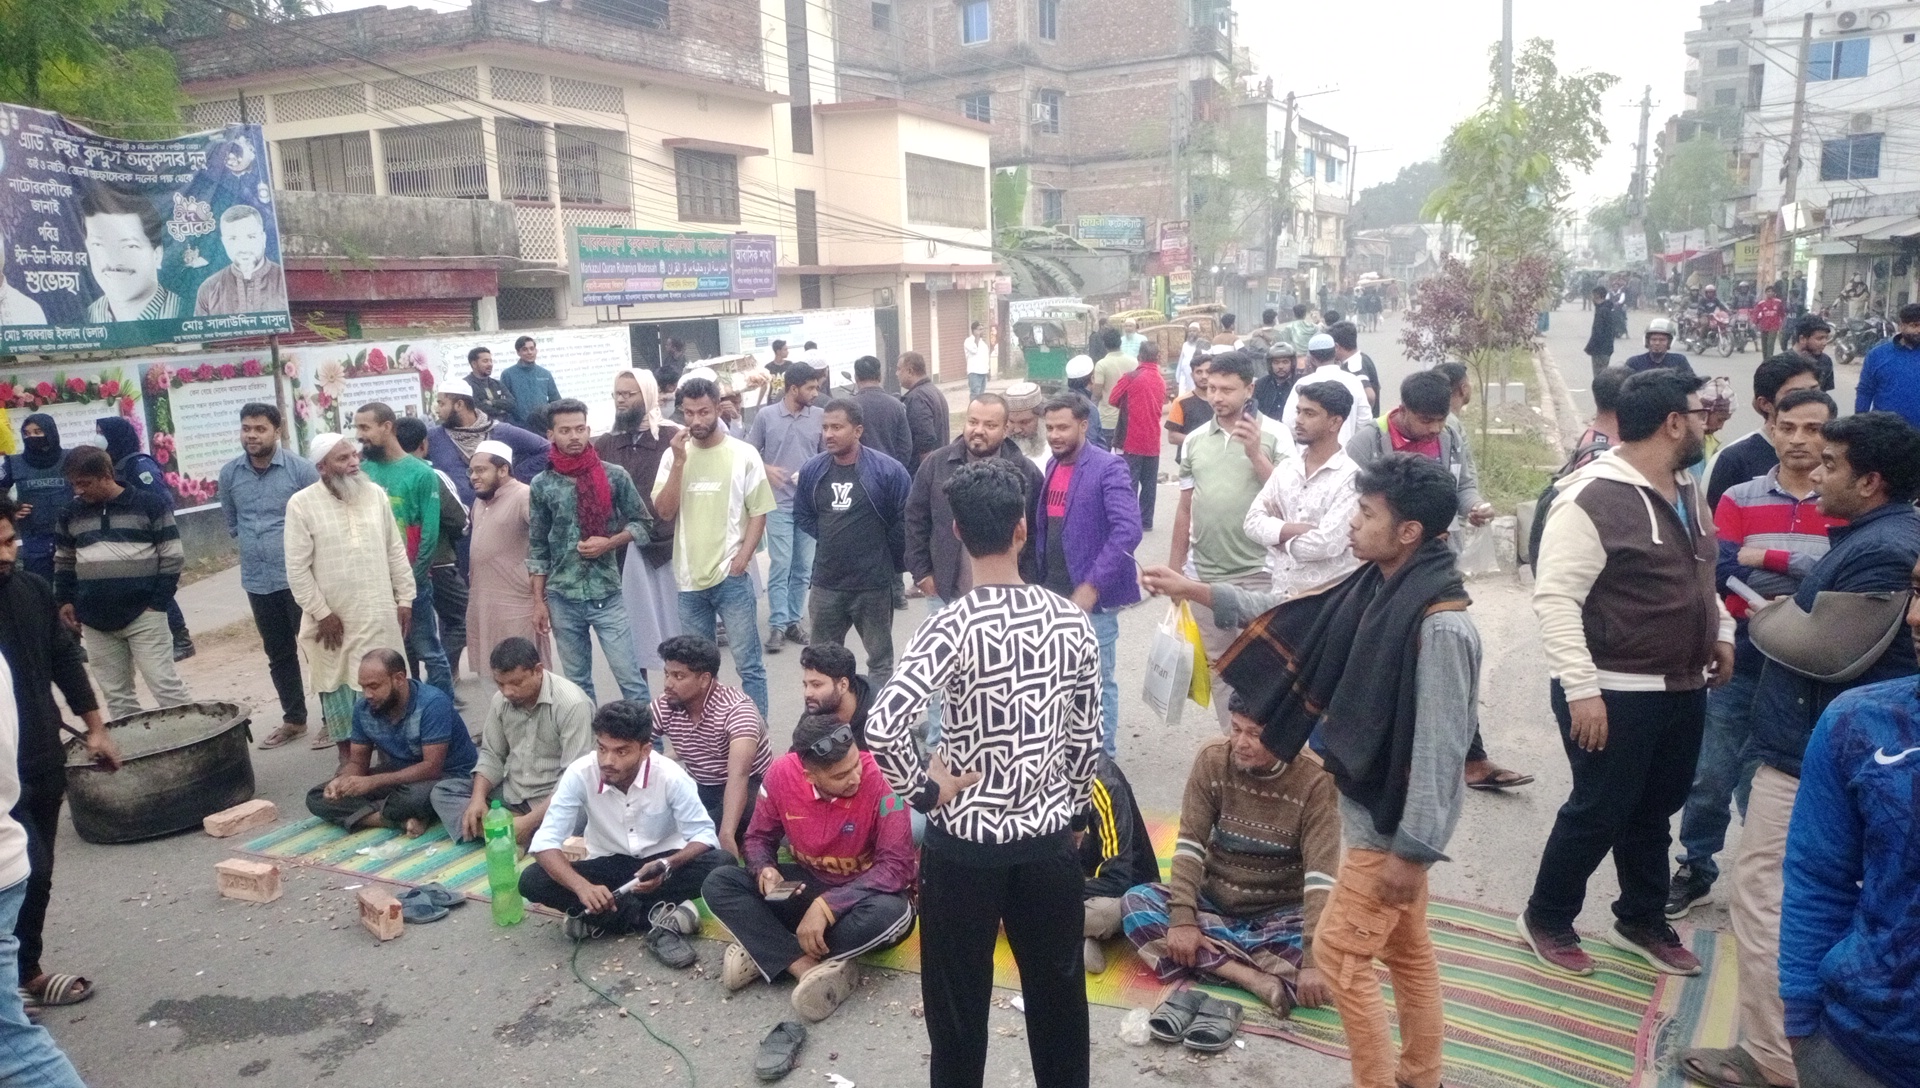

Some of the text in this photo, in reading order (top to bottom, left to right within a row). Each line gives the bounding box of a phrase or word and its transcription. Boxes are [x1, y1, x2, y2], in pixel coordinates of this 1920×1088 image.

[125, 151, 185, 172] তালুকদার
[187, 151, 208, 171] দুলু
[67, 165, 89, 177] জেলা
[7, 176, 73, 198] নাটোরবাসীকে
[29, 198, 61, 216] জানাই
[1080, 217, 1105, 227] মেঘনা
[38, 221, 59, 242] পবিত্র
[14, 244, 88, 266] ঈদ-উল-ফিতর এর
[735, 245, 772, 263] আবাসিক শাখা
[580, 262, 657, 275] Markazul Quran Ruhaniya Madrasah
[24, 270, 80, 295] শুভেচ্ছা
[181, 314, 287, 332] মোঃ সালাউদ্দিন মাসুদ
[4, 330, 20, 342] মোঃ
[55, 326, 81, 341] ইসলাম
[30, 479, 60, 487] POLICE
